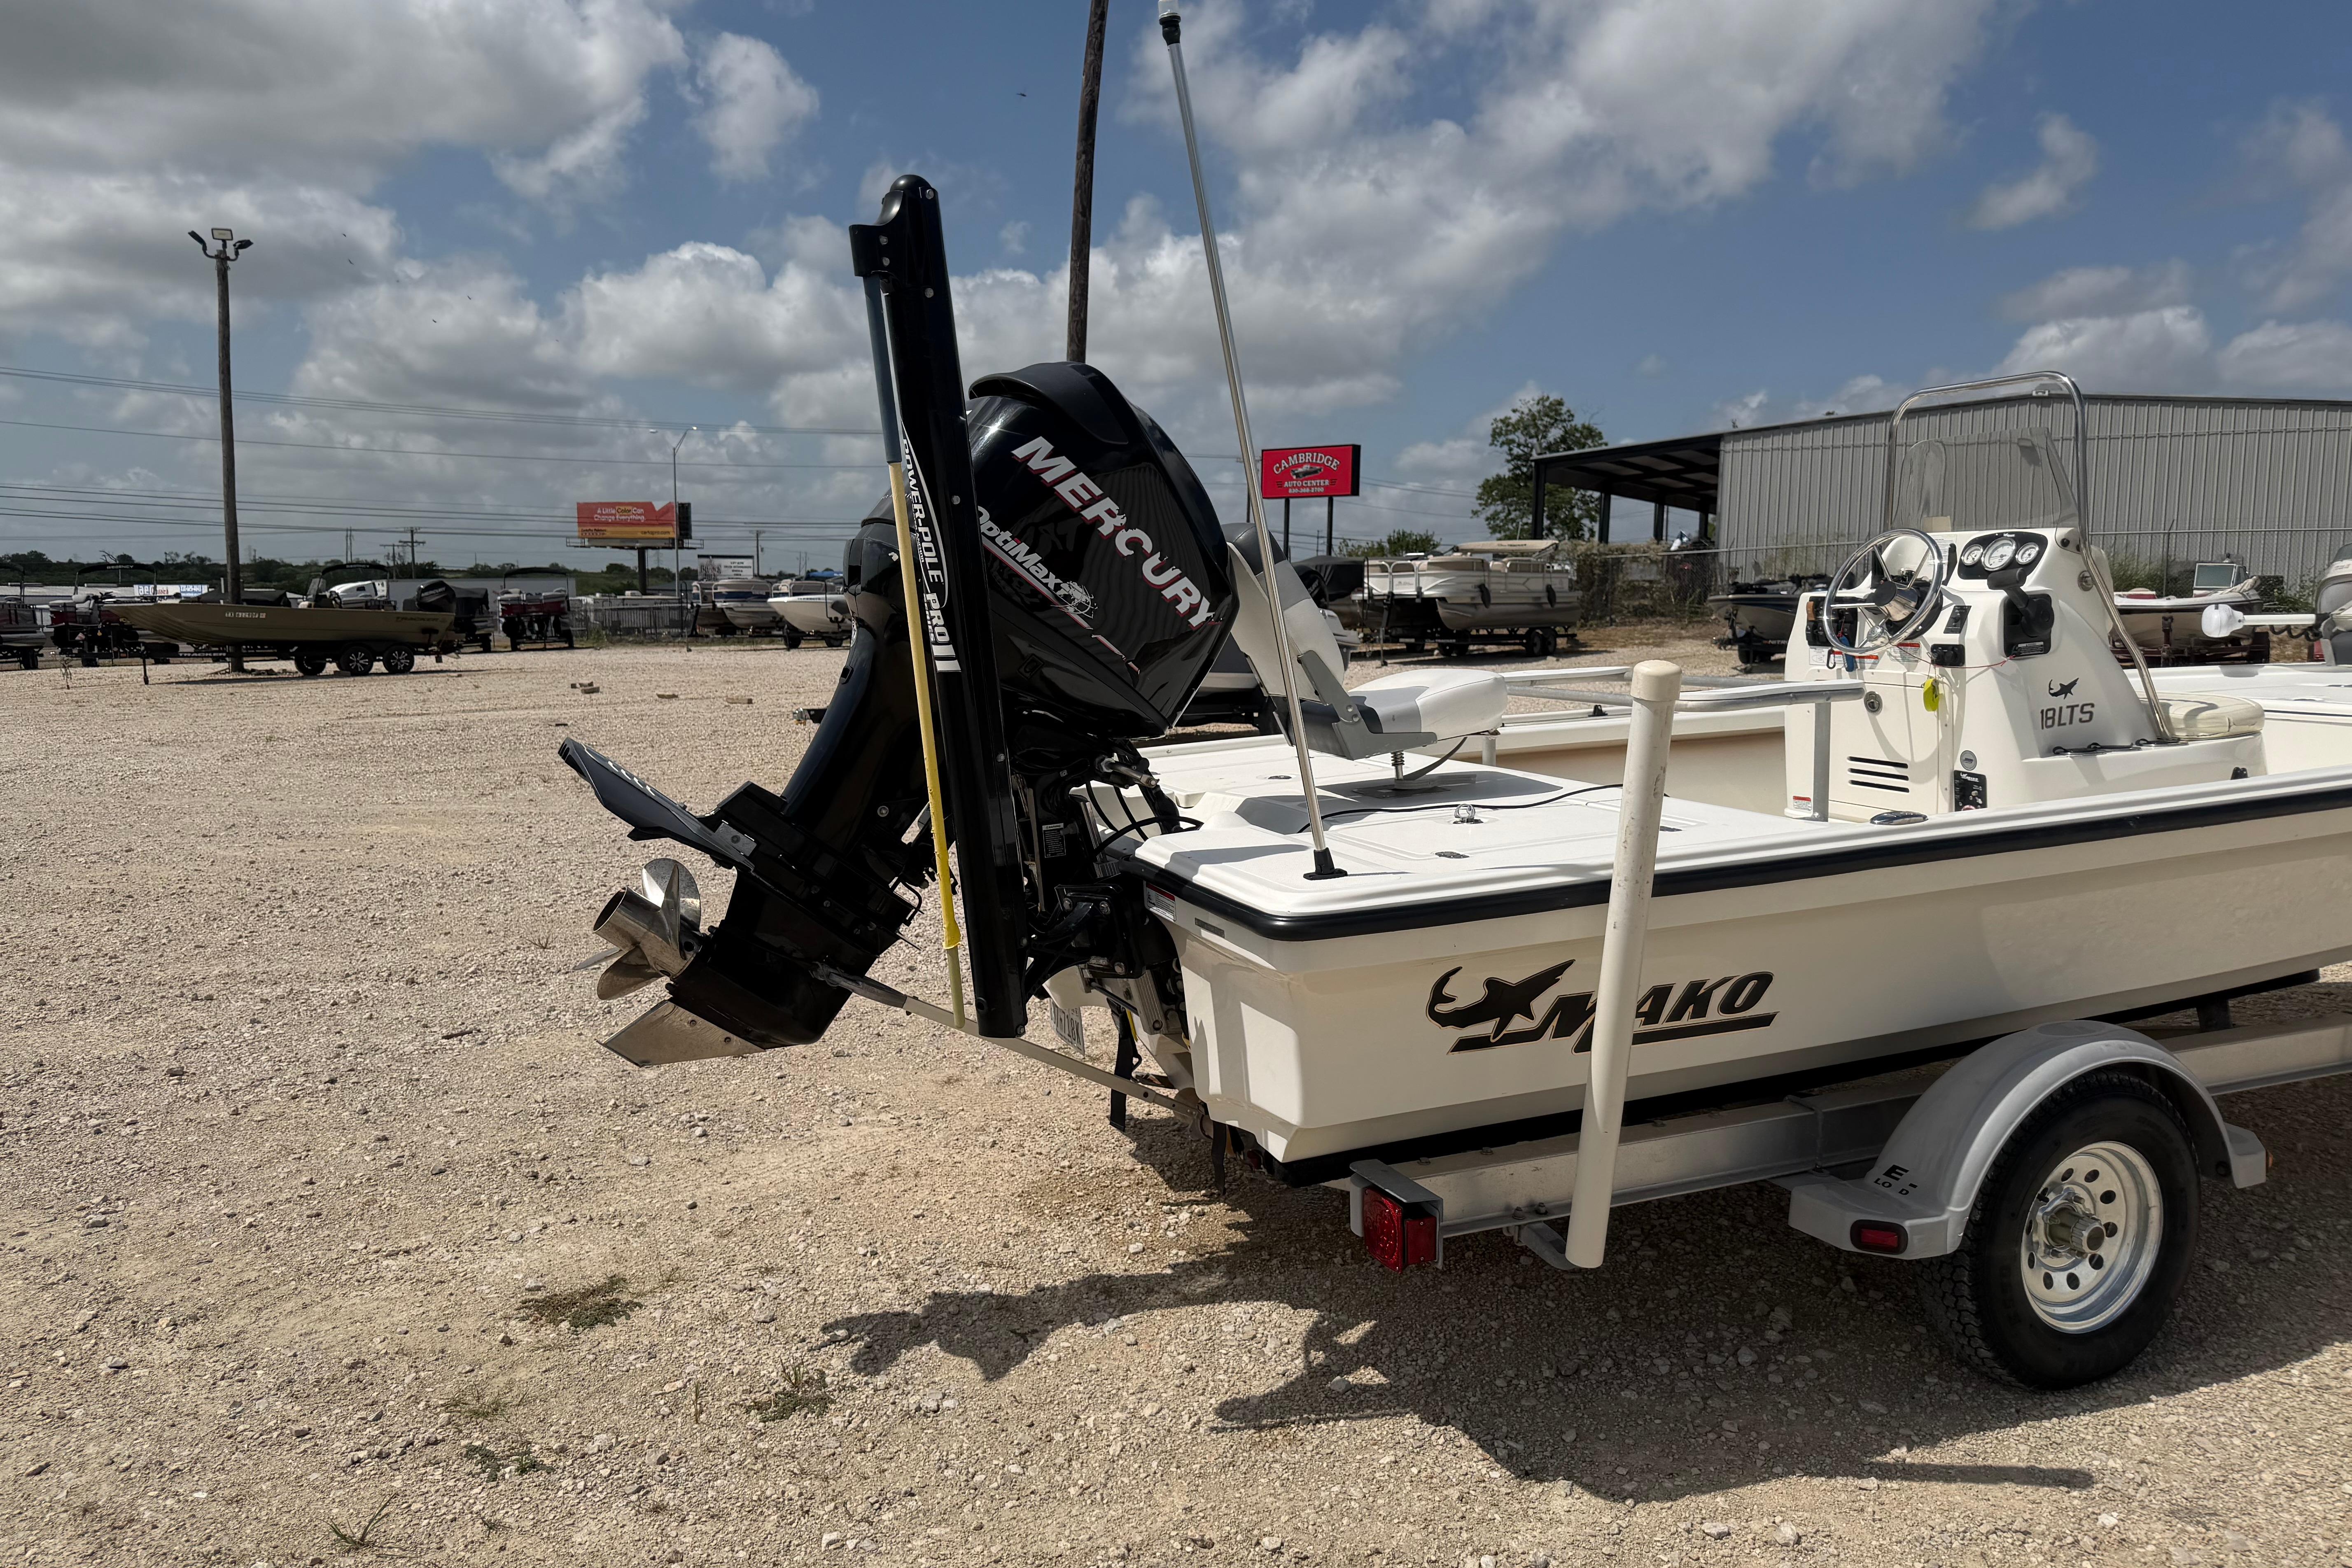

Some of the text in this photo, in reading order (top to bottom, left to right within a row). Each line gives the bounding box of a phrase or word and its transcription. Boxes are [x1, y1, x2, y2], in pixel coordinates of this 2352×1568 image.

[1273, 453, 1340, 474] CAMBRIDGE
[903, 439, 944, 583] POWER-POLE
[1011, 436, 1220, 630] MERCURY
[926, 593, 950, 643] PRO
[2040, 703, 2095, 730] 18LTS
[1543, 971, 1775, 1055] MAKO
